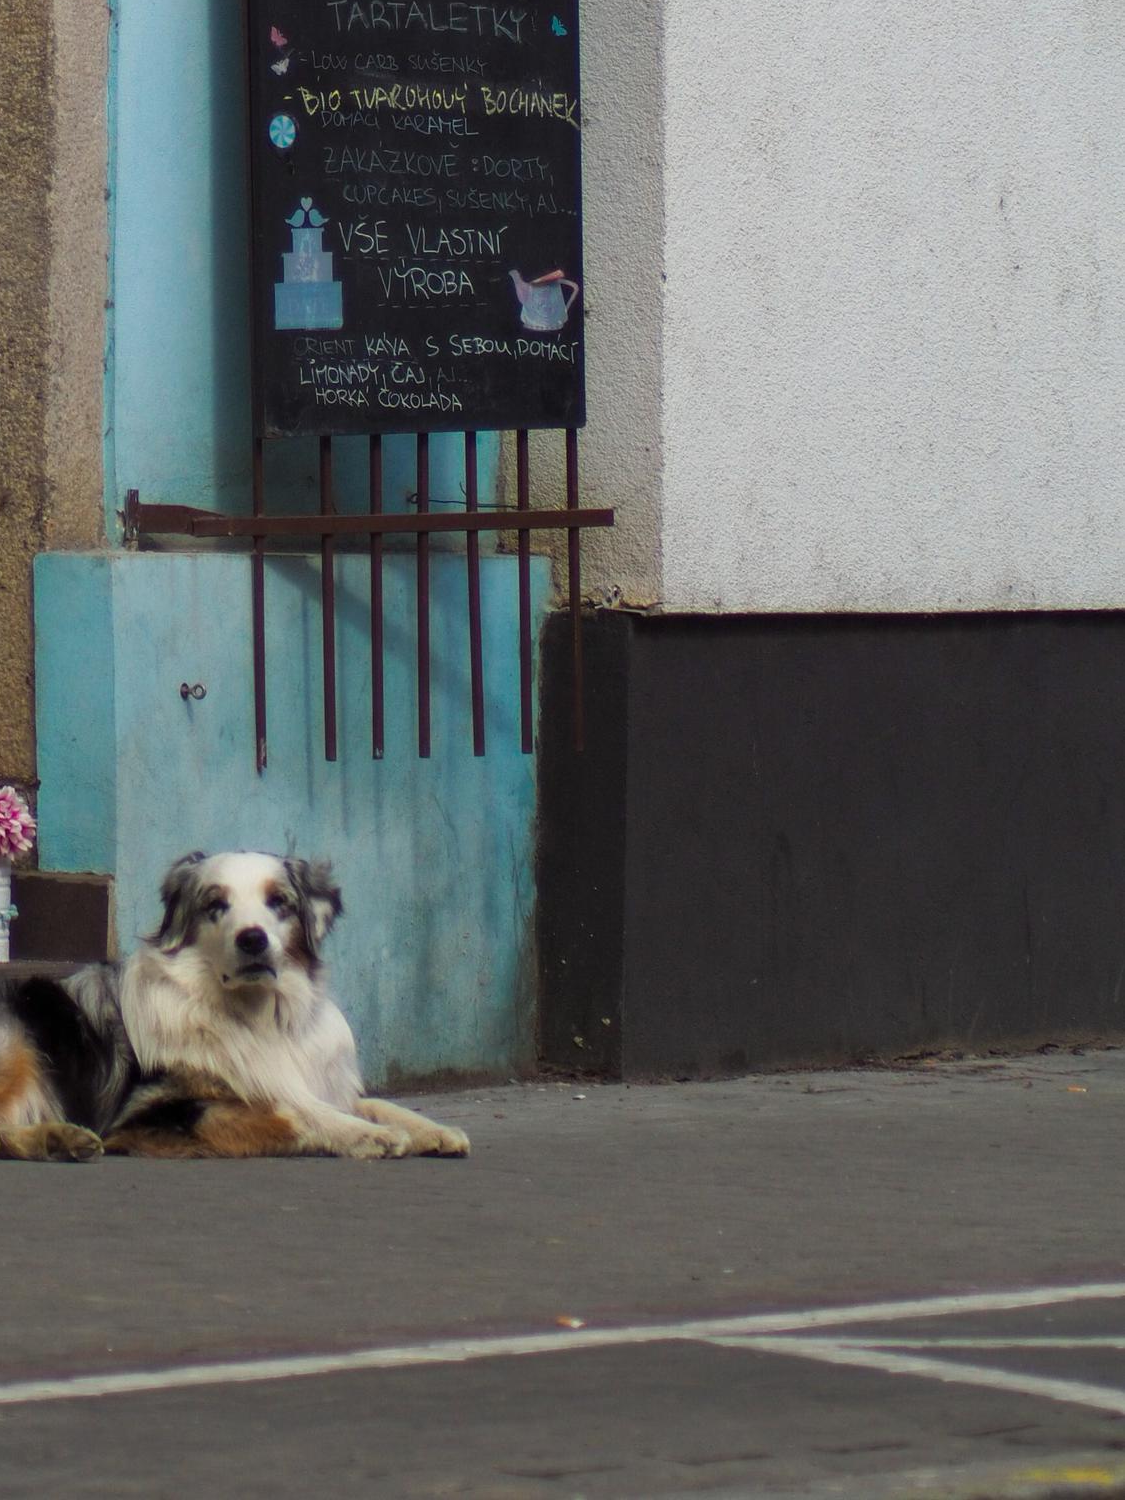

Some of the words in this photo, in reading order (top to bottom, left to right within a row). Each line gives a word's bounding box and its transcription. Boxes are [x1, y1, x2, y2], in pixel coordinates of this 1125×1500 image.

[408, 49, 489, 77] SUŠENKY
[296, 86, 341, 116] BIO
[349, 81, 468, 114] TVAROHOVÝ
[391, 114, 479, 135] KARAMEL
[338, 214, 390, 254] VŠE
[405, 223, 509, 256] VLASTNÍ
[377, 258, 475, 300] VÝROBA
[364, 332, 411, 357] KÁVA
[425, 336, 440, 357] S
[315, 385, 370, 407] HORKÁ
[378, 383, 463, 412] ČOKOLÁDA
